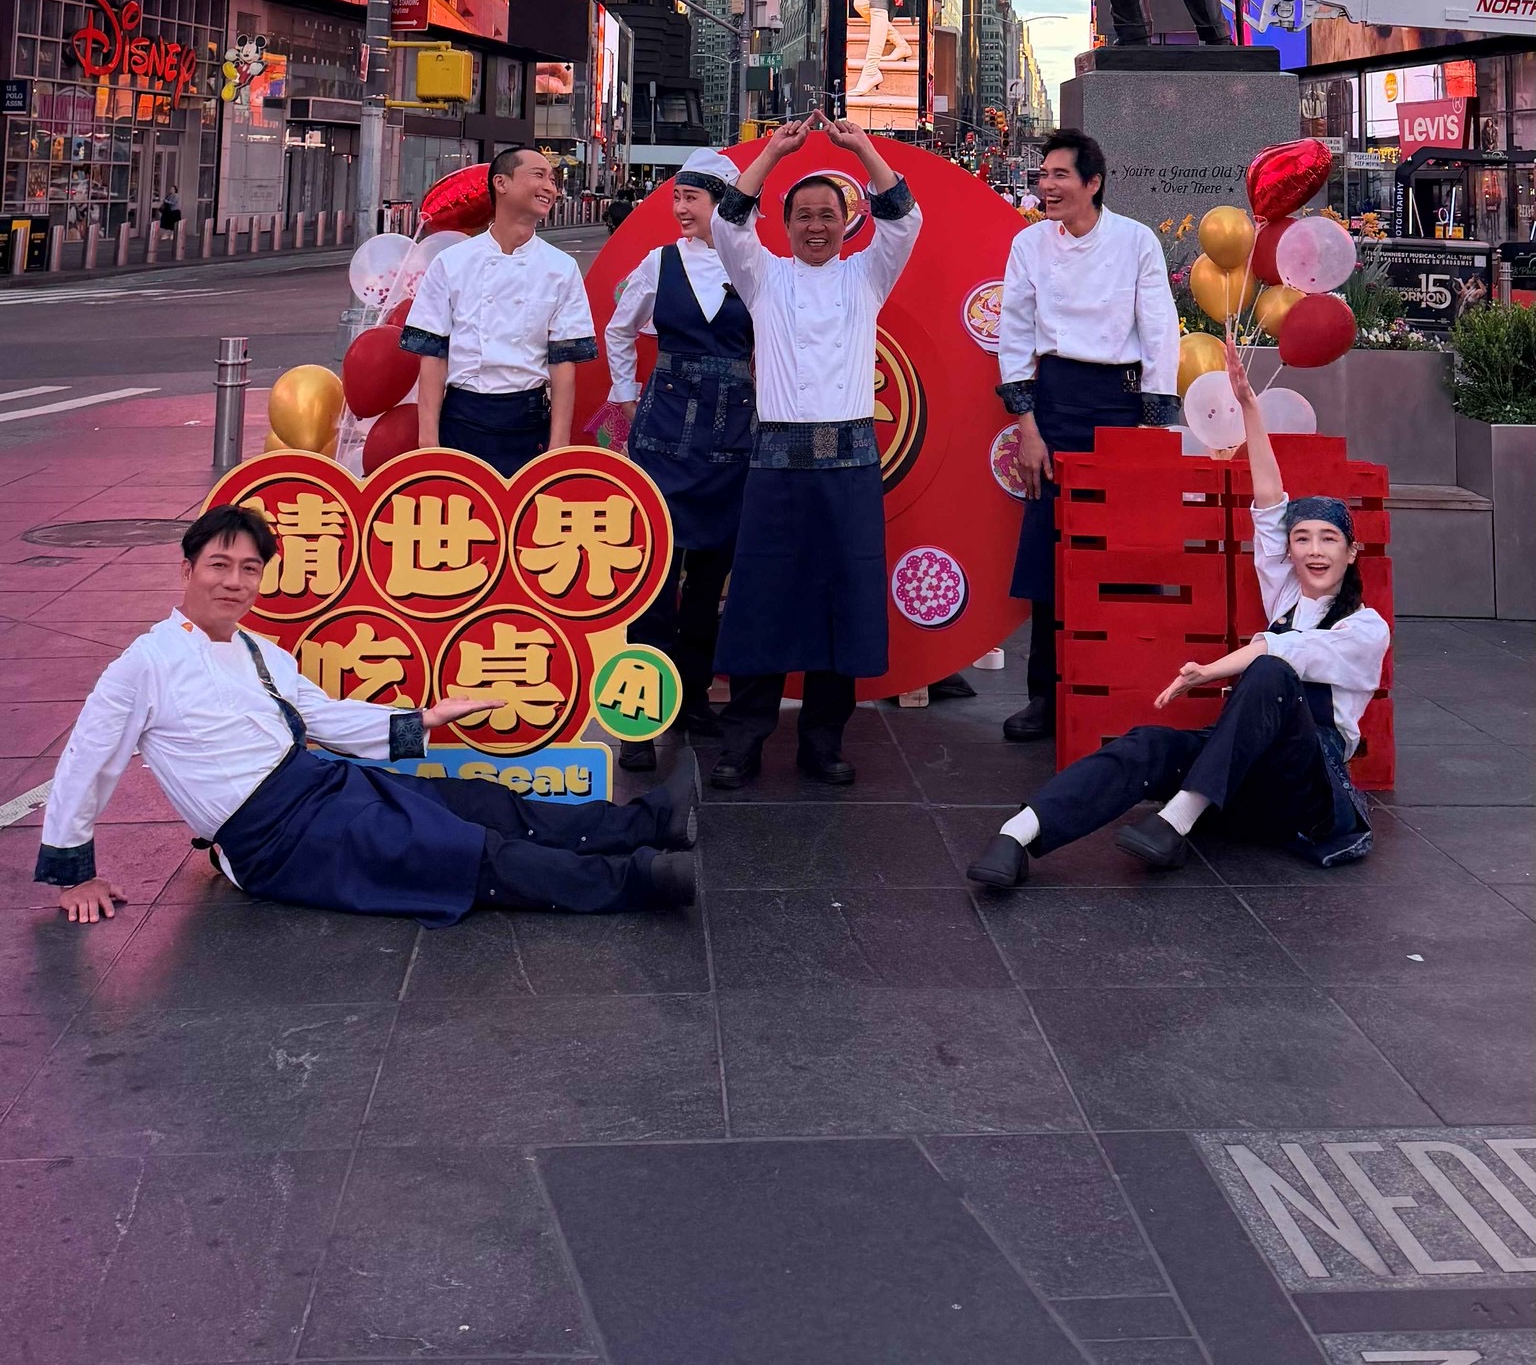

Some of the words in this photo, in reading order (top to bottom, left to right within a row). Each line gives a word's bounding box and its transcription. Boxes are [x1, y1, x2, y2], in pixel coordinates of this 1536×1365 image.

[767, 55, 775, 65] 46
[5, 92, 23, 100] POLO
[1122, 165, 1155, 180] You're
[1158, 168, 1166, 177] a
[1170, 165, 1207, 180] Grand
[1211, 165, 1232, 178] Old
[1161, 180, 1188, 194] Over
[1191, 180, 1221, 194] There
[1400, 292, 1446, 303] ORMON
[1418, 273, 1451, 309] 15
[299, 622, 565, 731] 吃桌
